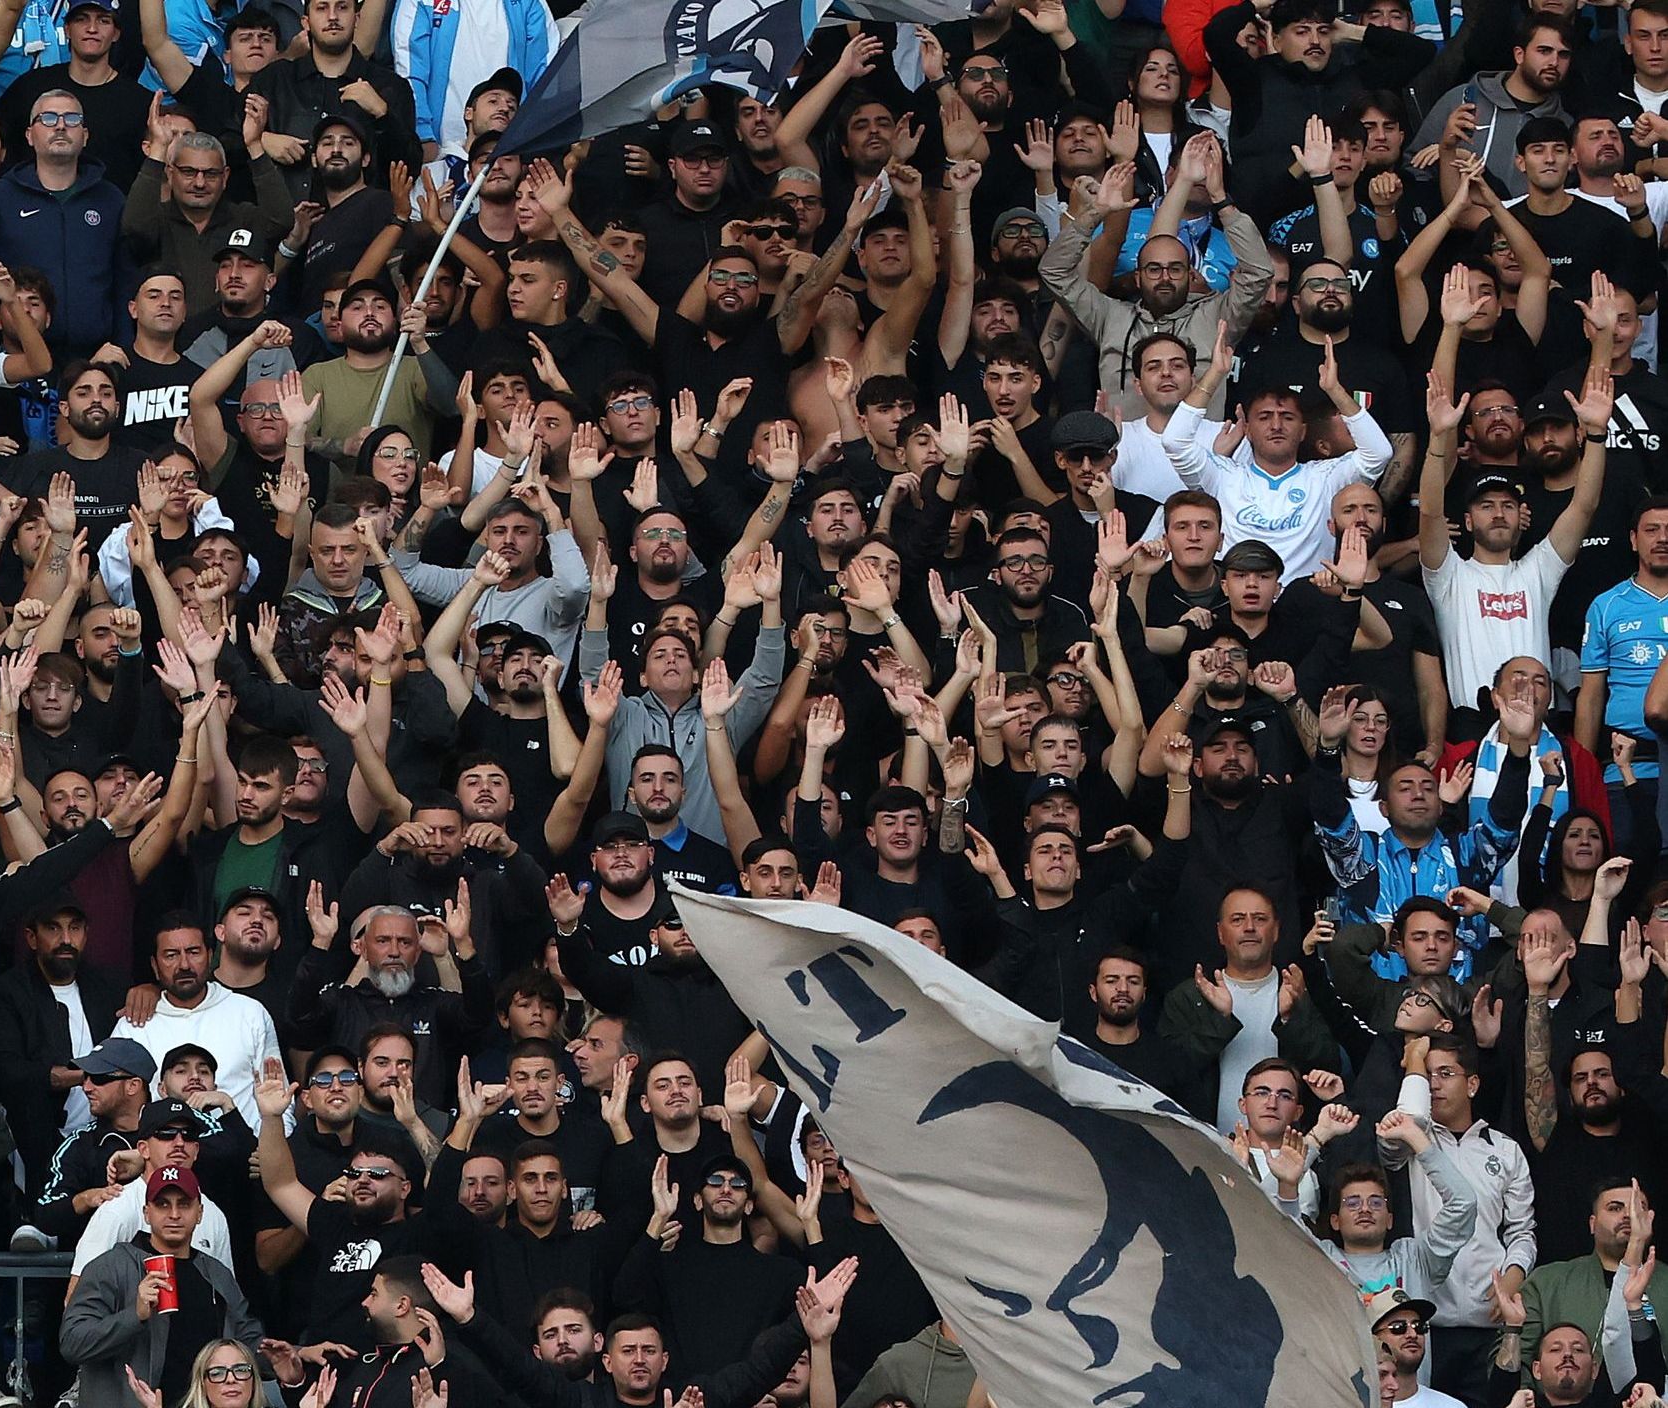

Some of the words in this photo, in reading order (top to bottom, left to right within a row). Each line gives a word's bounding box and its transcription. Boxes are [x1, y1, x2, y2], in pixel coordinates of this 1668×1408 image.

[1291, 242, 1314, 254] EA7
[124, 385, 191, 427] NIKE
[1618, 620, 1641, 634] EA7
[162, 1167, 179, 1181] NY
